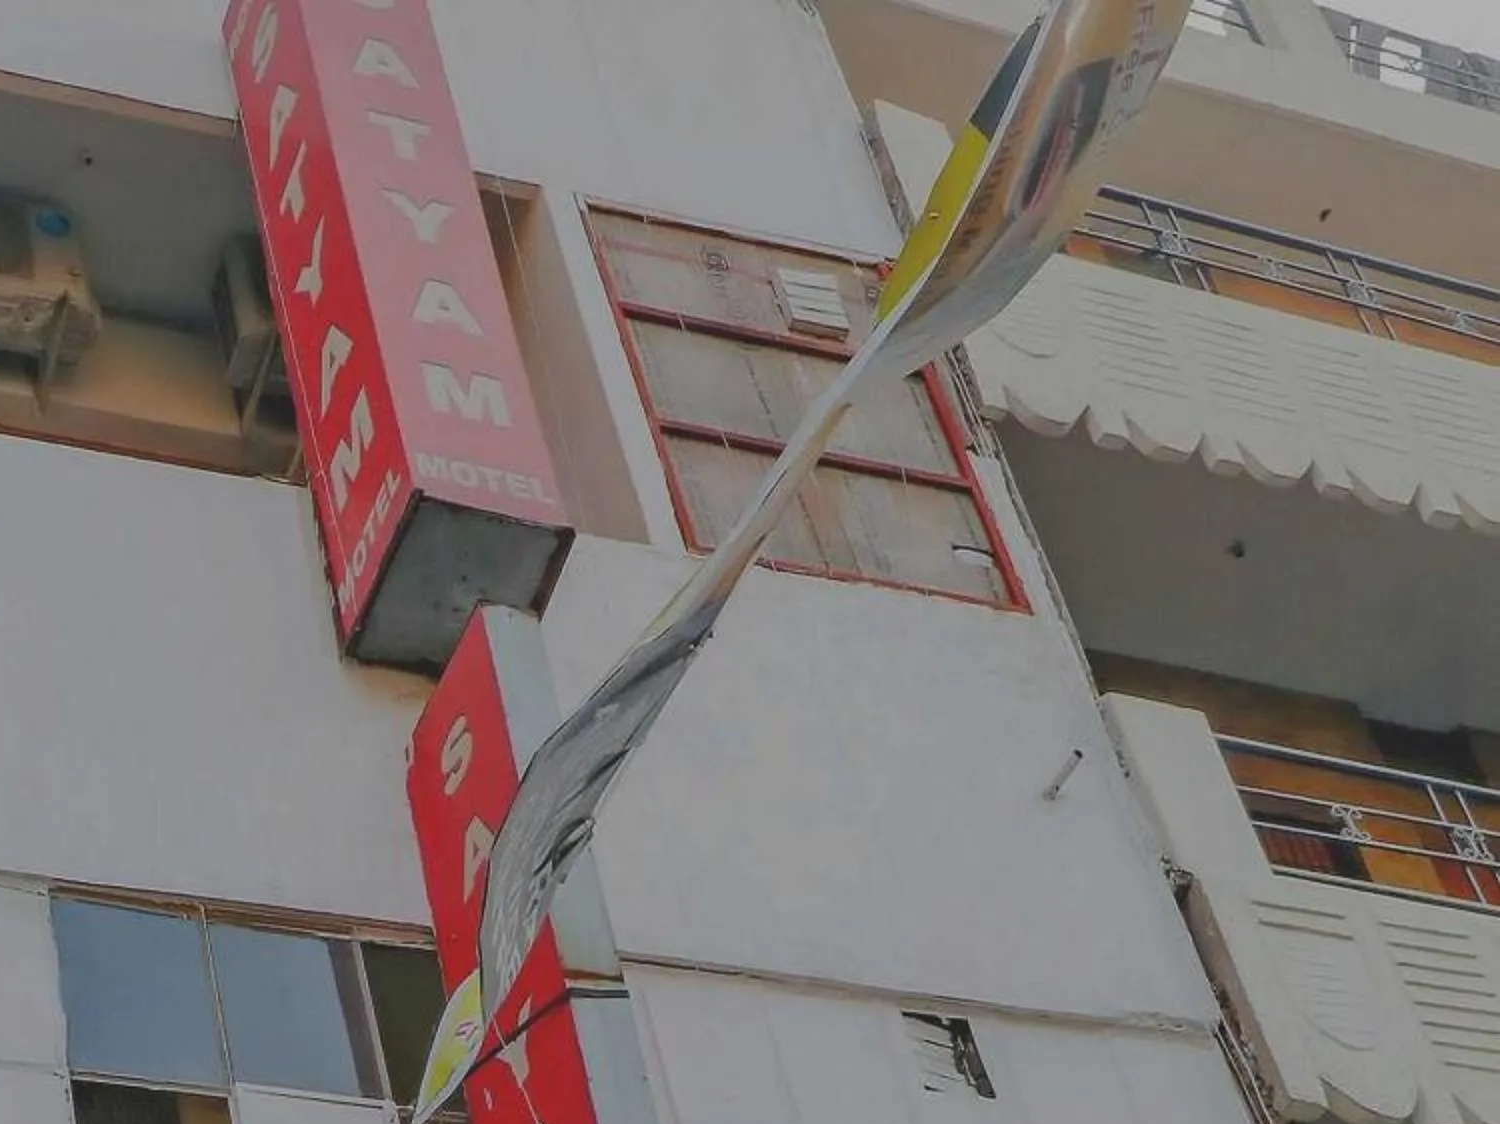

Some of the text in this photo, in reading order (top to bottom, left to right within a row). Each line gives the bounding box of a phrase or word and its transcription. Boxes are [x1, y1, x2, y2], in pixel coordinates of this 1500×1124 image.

[252, 3, 374, 513] SATYAM
[353, 0, 512, 427] ATYAM
[337, 468, 402, 615] MOTEL
[414, 451, 557, 504] MOTEL
